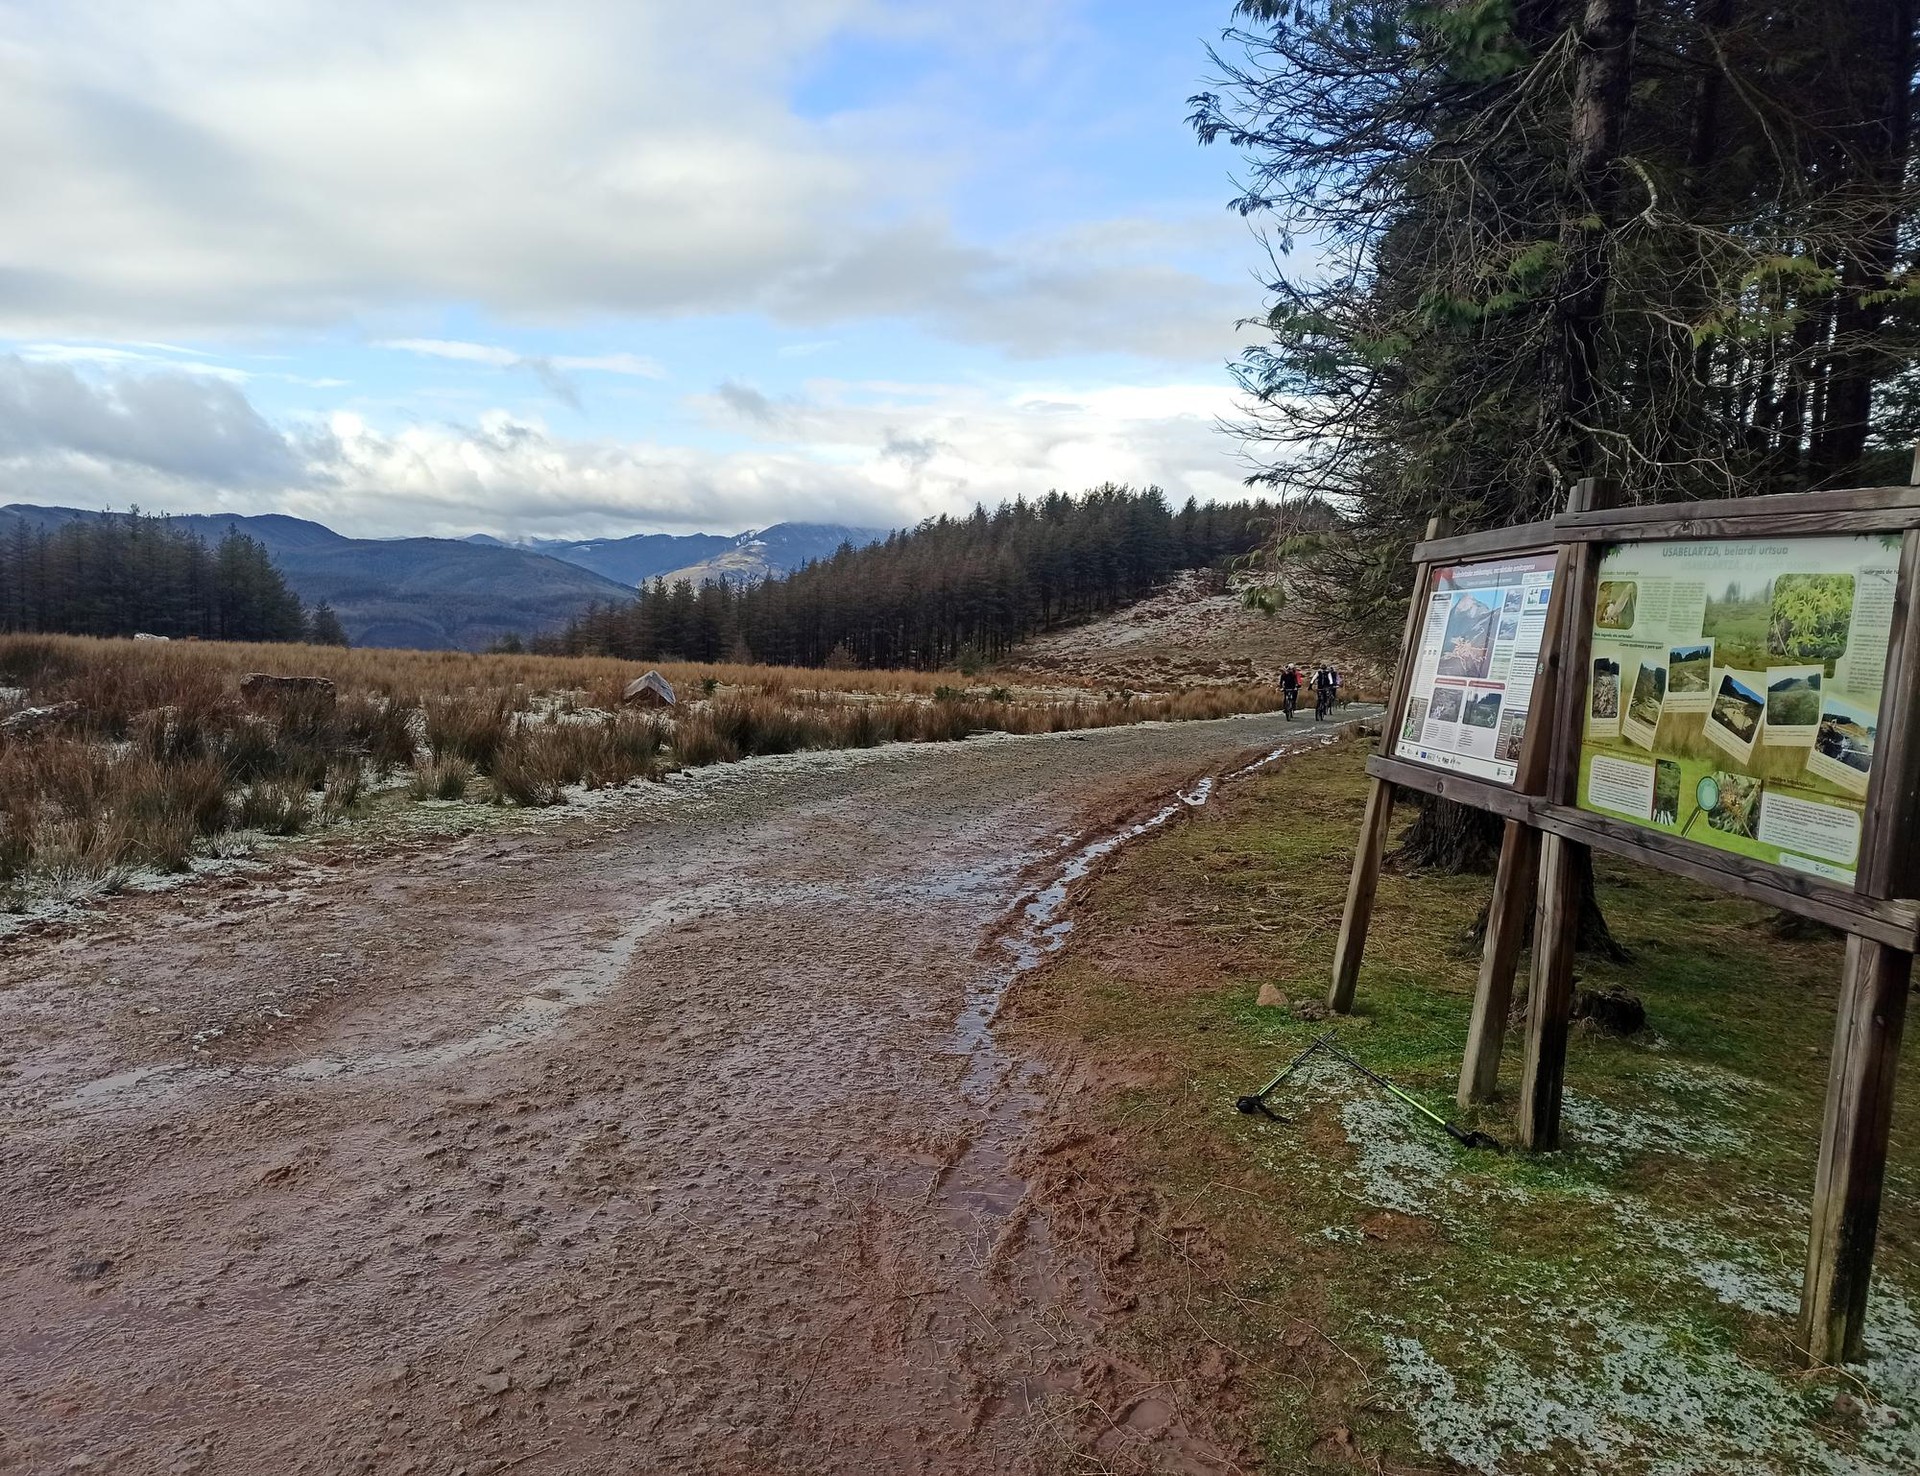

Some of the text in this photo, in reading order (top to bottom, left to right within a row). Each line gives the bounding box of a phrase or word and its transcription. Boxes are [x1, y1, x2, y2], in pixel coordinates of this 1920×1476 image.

[1662, 544, 1789, 558] USABELARTZA, belardi urtsua
